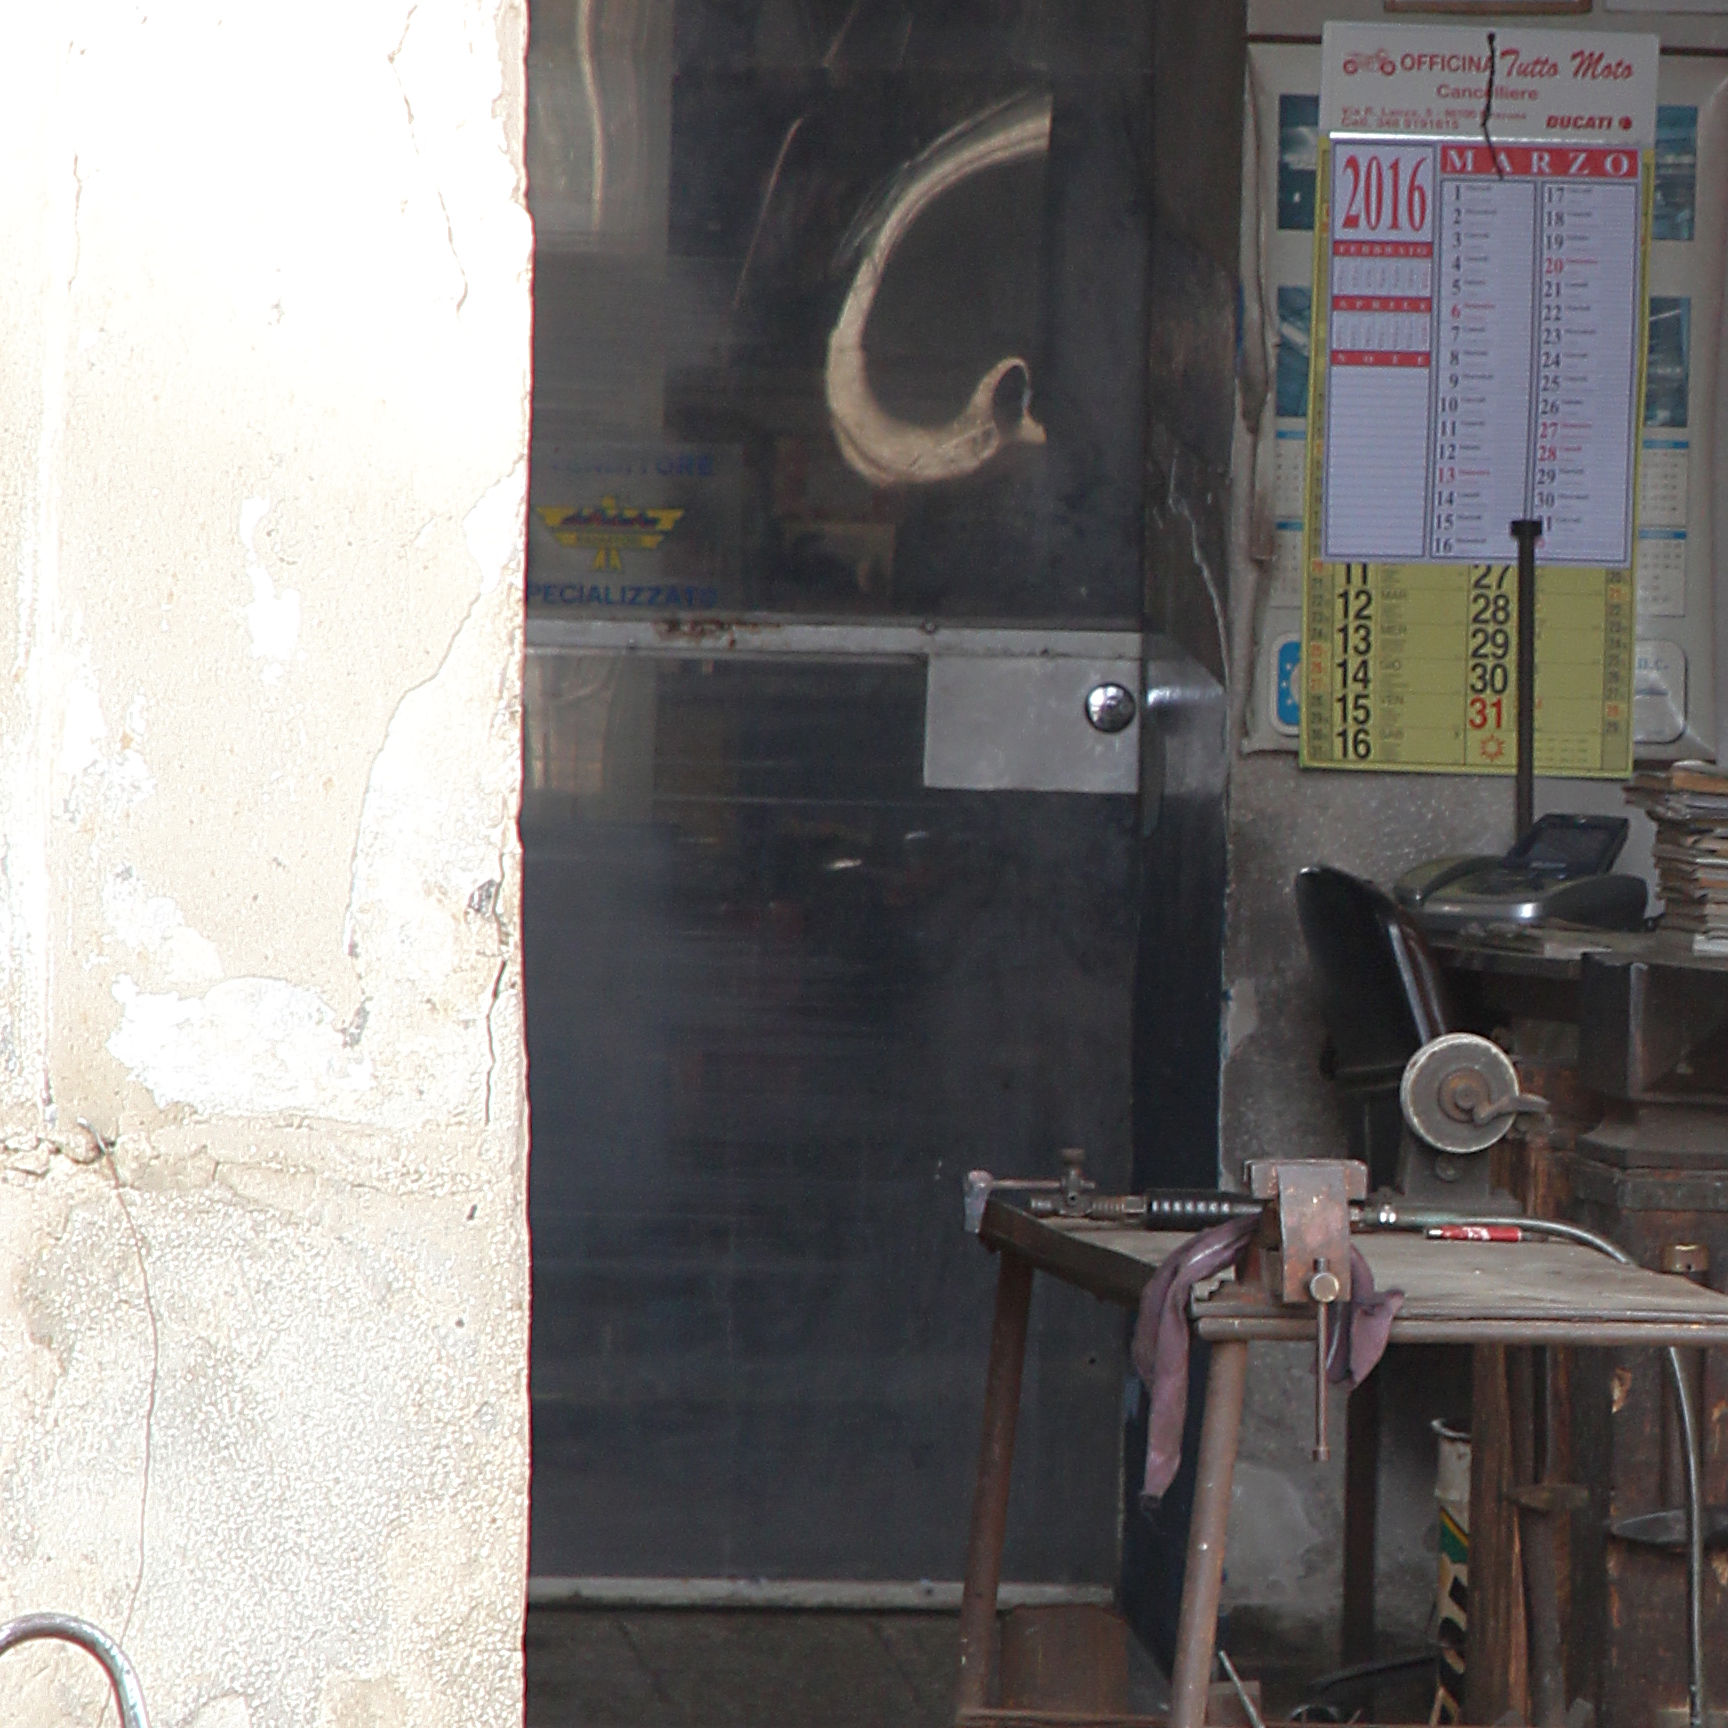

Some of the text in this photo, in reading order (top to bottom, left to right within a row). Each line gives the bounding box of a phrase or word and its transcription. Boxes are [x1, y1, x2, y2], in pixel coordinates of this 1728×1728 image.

[1501, 48, 1559, 79] Tutto
[1570, 49, 1634, 80] Moto
[1546, 115, 1613, 130] DUCATI
[1448, 148, 1629, 175] MARZO
[1341, 154, 1427, 232] 2016
[1454, 185, 1461, 200] 1
[1547, 187, 1564, 203] 17
[1453, 208, 1461, 224] 2
[1546, 211, 1564, 227] 18
[1453, 232, 1461, 248] 3
[1546, 234, 1564, 250] 19
[1452, 256, 1461, 271] 4
[1545, 258, 1564, 273] 20
[1452, 279, 1460, 295] 5
[1544, 280, 1561, 297] 21
[1451, 303, 1460, 318] 6
[1544, 305, 1561, 321] 22
[1450, 326, 1460, 342] 7
[1543, 328, 1561, 344] 23
[1450, 351, 1459, 365] 8
[1542, 352, 1561, 368] 24
[1450, 373, 1459, 388] 9
[1542, 375, 1560, 391] 25
[1441, 397, 1458, 412] 10
[1541, 399, 1559, 414] 26
[1441, 421, 1456, 436] 11
[1540, 422, 1558, 439] 27
[1440, 444, 1455, 460] 12
[1539, 446, 1557, 462] 28
[1438, 467, 1455, 483] 13
[1537, 469, 1556, 484] 29
[1438, 491, 1454, 506] 14
[1537, 493, 1555, 508] 30
[1436, 514, 1454, 529] 15
[1435, 537, 1452, 553] 16
[1343, 565, 1368, 585] 11
[1472, 564, 1511, 589] 27
[1337, 589, 1372, 620] 12
[1471, 594, 1510, 625] 28
[1337, 625, 1371, 655] 13
[1470, 628, 1509, 659] 29
[1336, 660, 1371, 690] 14
[1469, 663, 1508, 695] 30
[1336, 694, 1371, 724] 15
[1469, 697, 1505, 730] 31
[1336, 728, 1371, 759] 16
